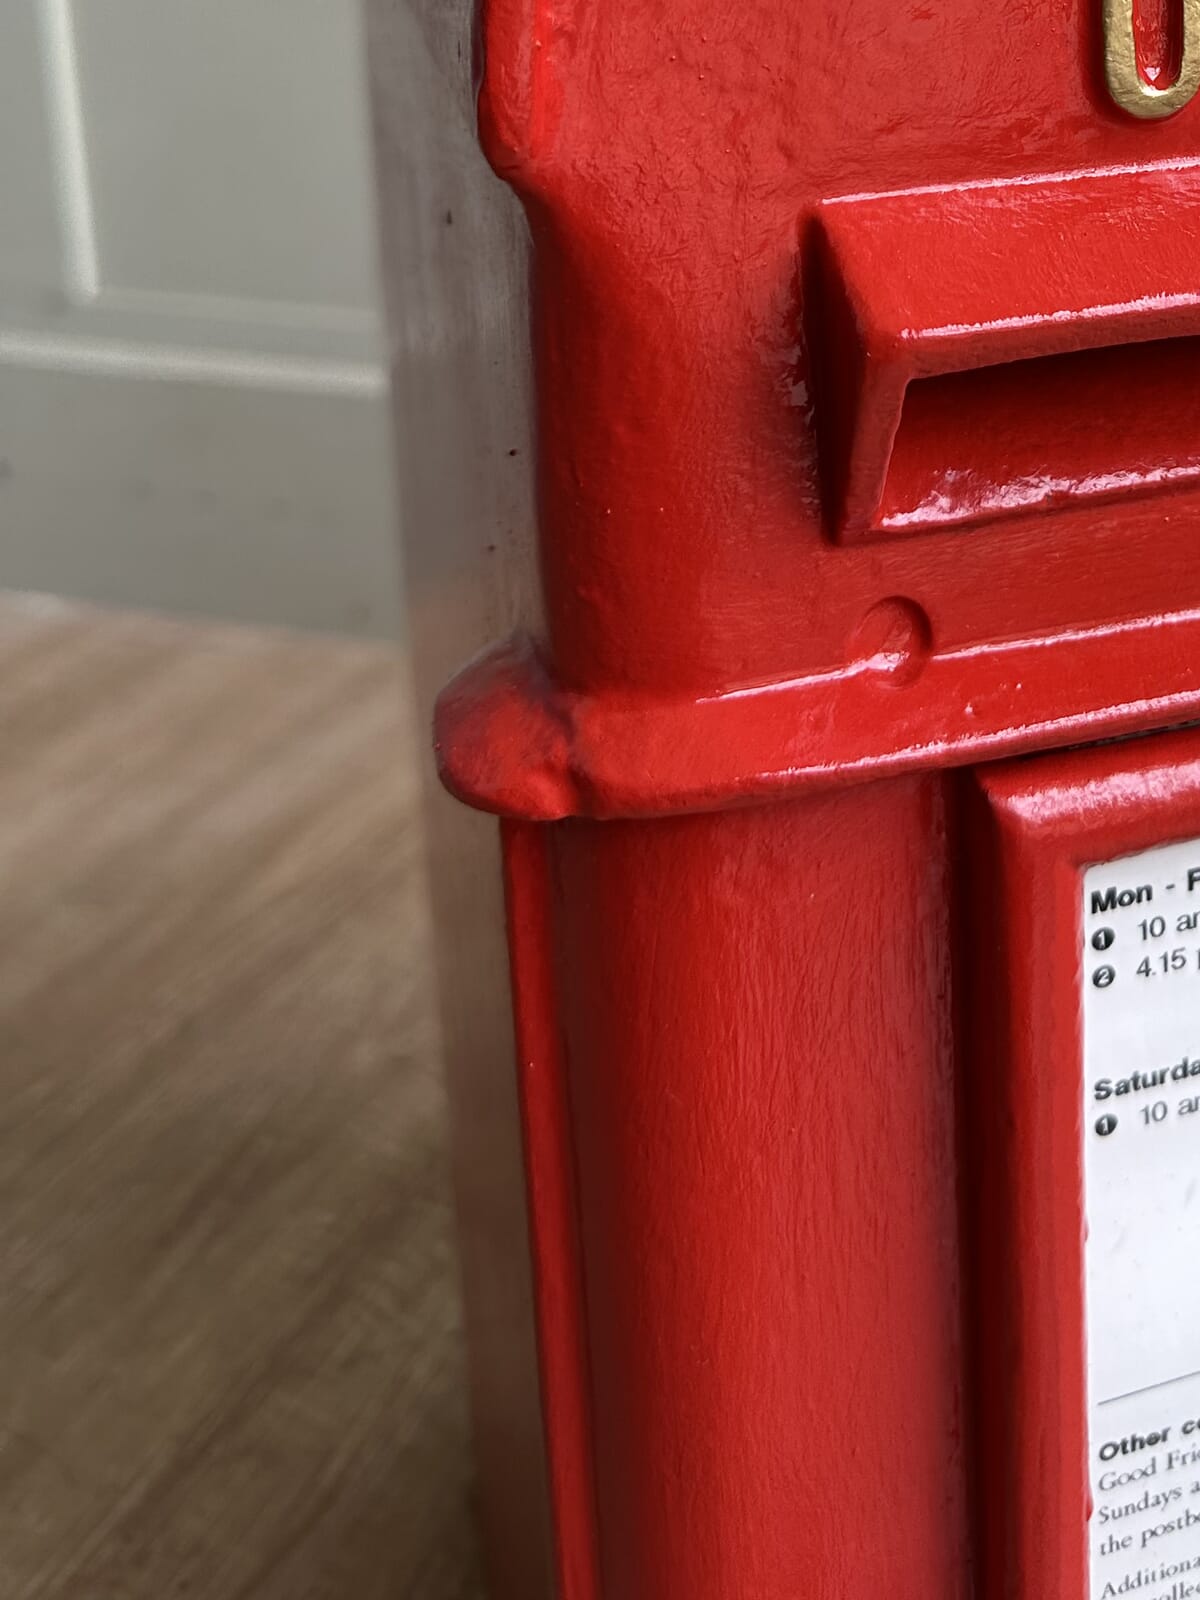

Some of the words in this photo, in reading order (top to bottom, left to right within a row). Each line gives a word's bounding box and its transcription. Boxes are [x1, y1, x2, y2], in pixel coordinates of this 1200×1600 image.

[1091, 884, 1153, 914] Mon
[1137, 914, 1167, 941] 10
[1136, 946, 1188, 978] 4.15
[1140, 1100, 1168, 1125] 10
[1098, 1426, 1172, 1462] Other
[1098, 1455, 1158, 1492] Good
[1098, 1486, 1182, 1525] Sundays
[1100, 1534, 1133, 1556] the
